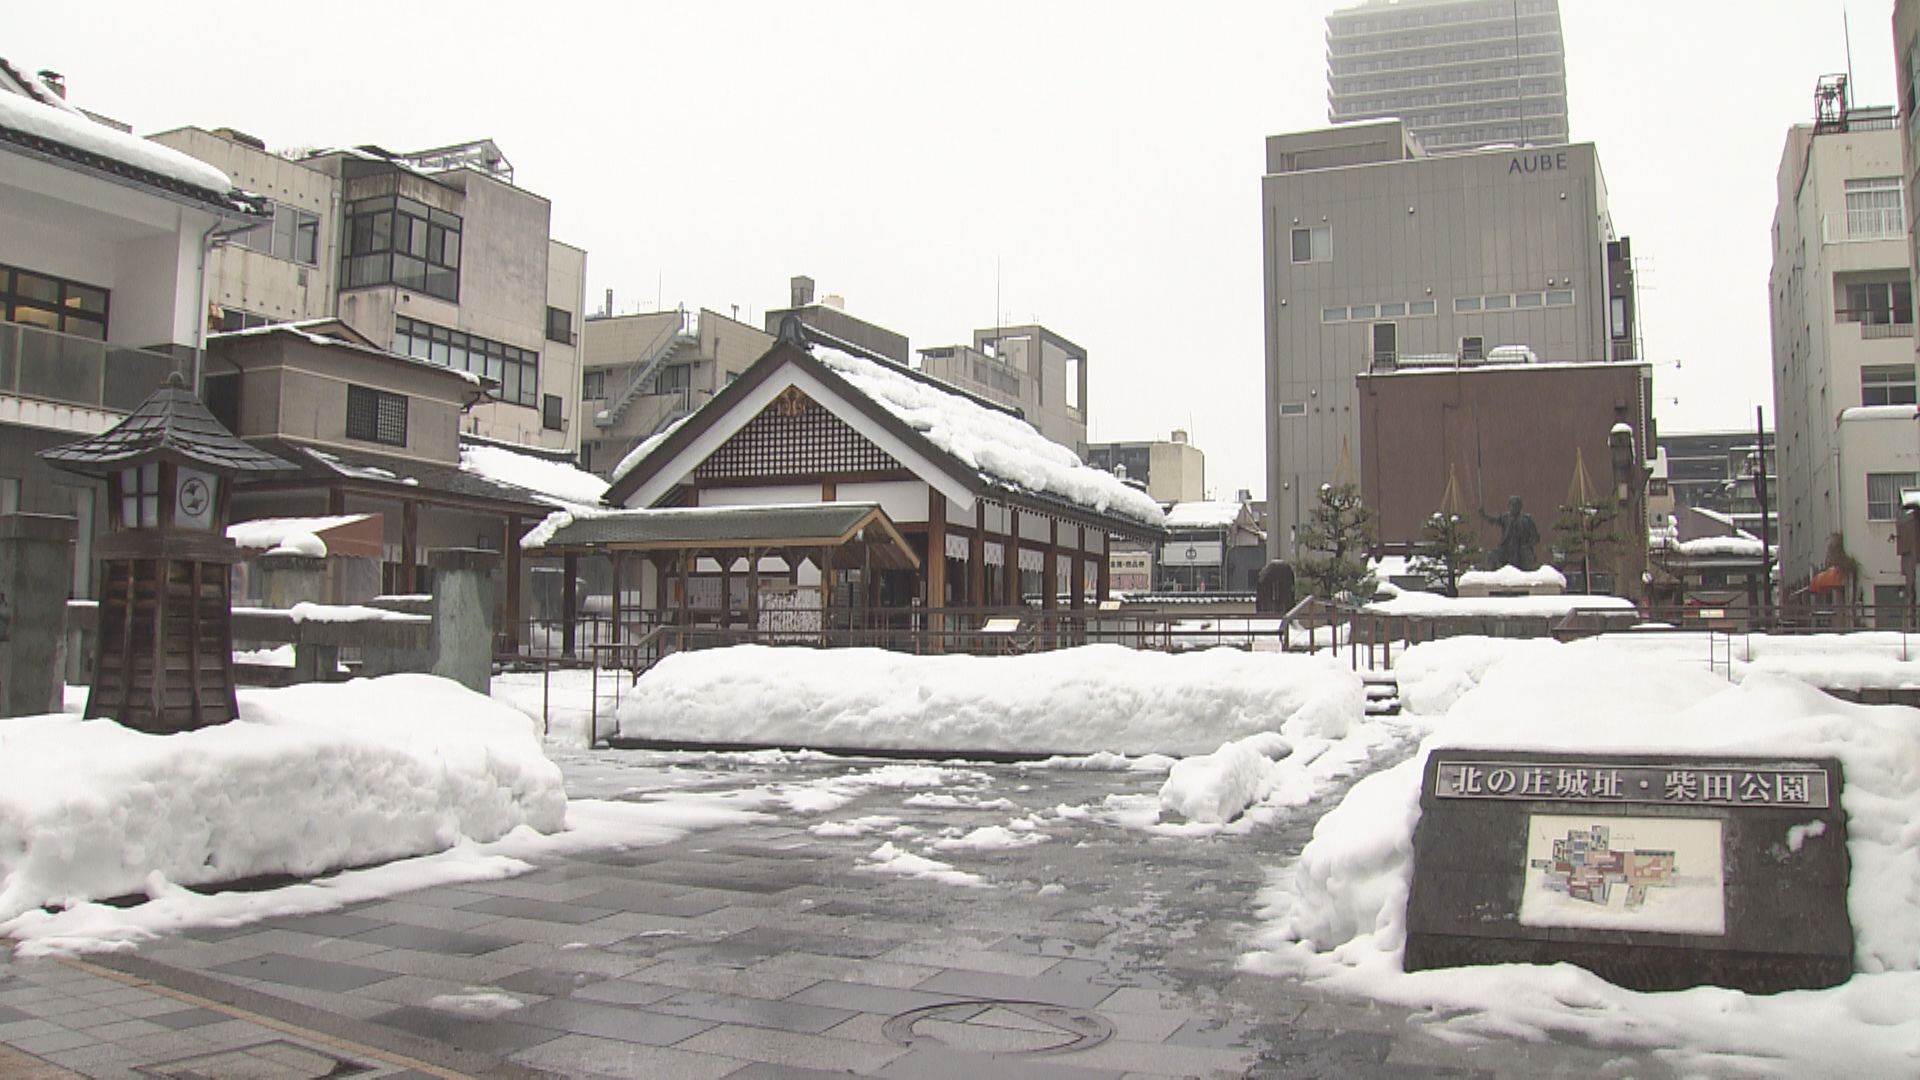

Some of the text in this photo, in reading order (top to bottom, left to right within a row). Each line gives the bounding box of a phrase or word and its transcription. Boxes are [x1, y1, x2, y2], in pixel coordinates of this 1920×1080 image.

[1509, 152, 1567, 174] AUBE
[1452, 766, 1809, 803] 北の庄城址・柴田公園
